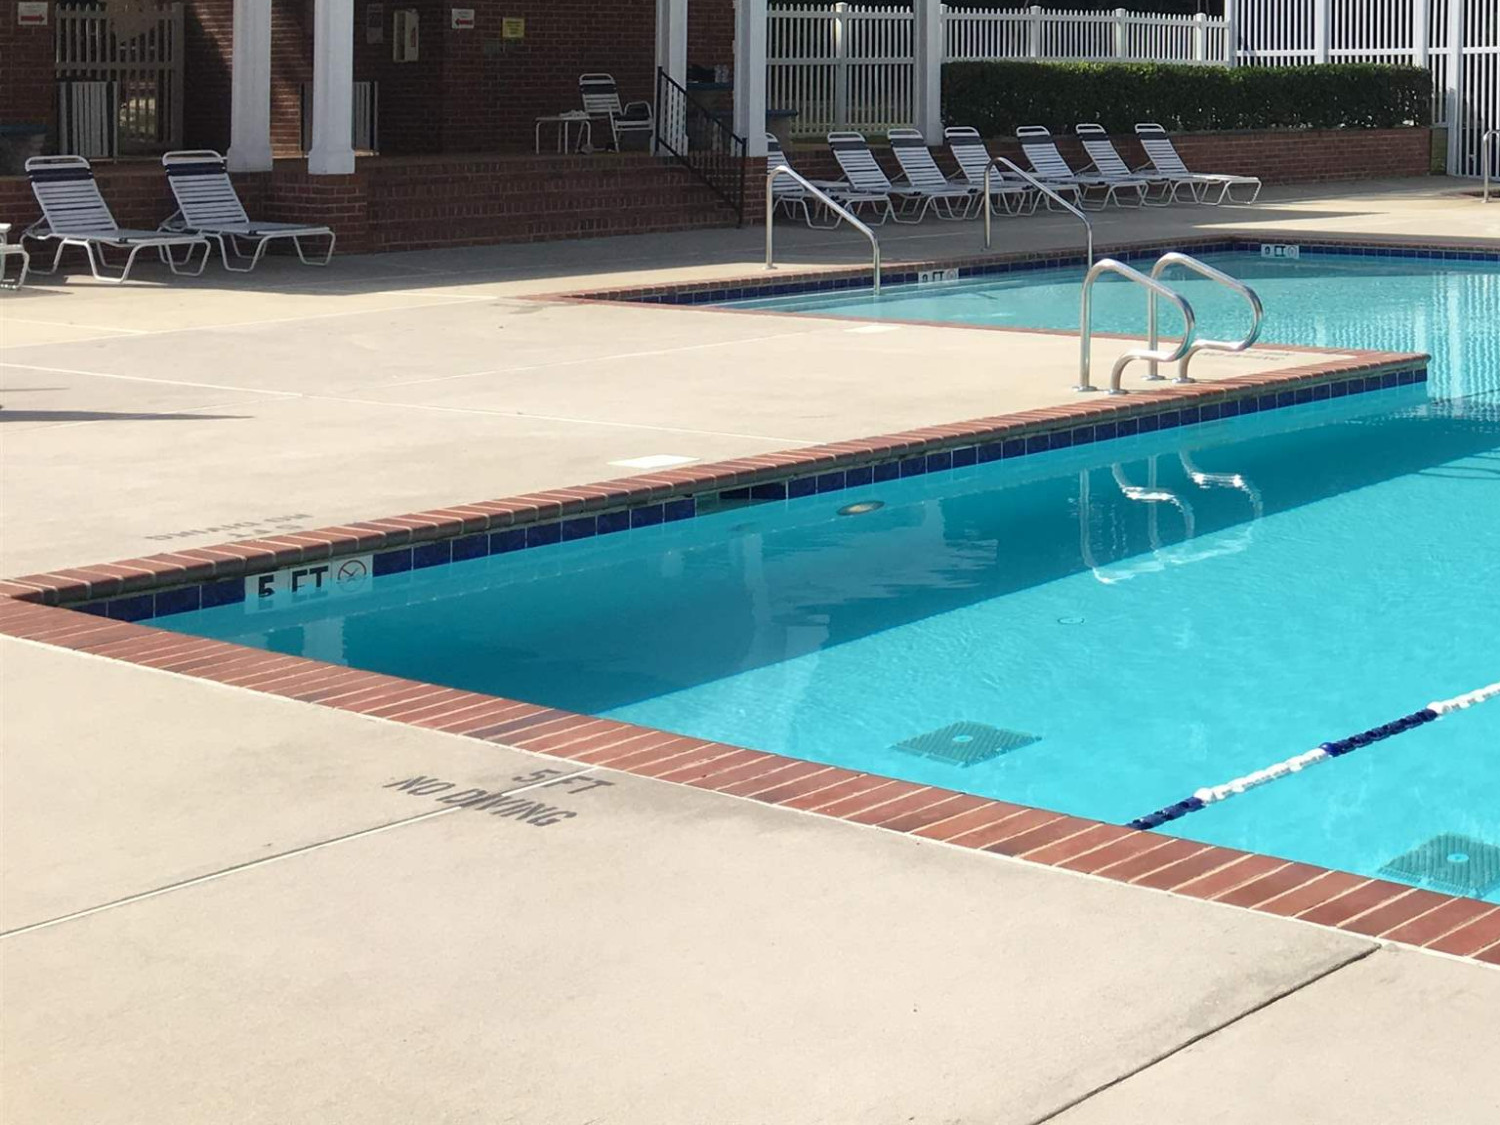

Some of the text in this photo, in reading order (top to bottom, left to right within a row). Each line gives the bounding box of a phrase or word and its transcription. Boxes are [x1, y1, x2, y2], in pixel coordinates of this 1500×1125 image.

[258, 565, 329, 598] 5 FT
[382, 775, 578, 827] NO DIVING
[542, 774, 615, 795] FT
